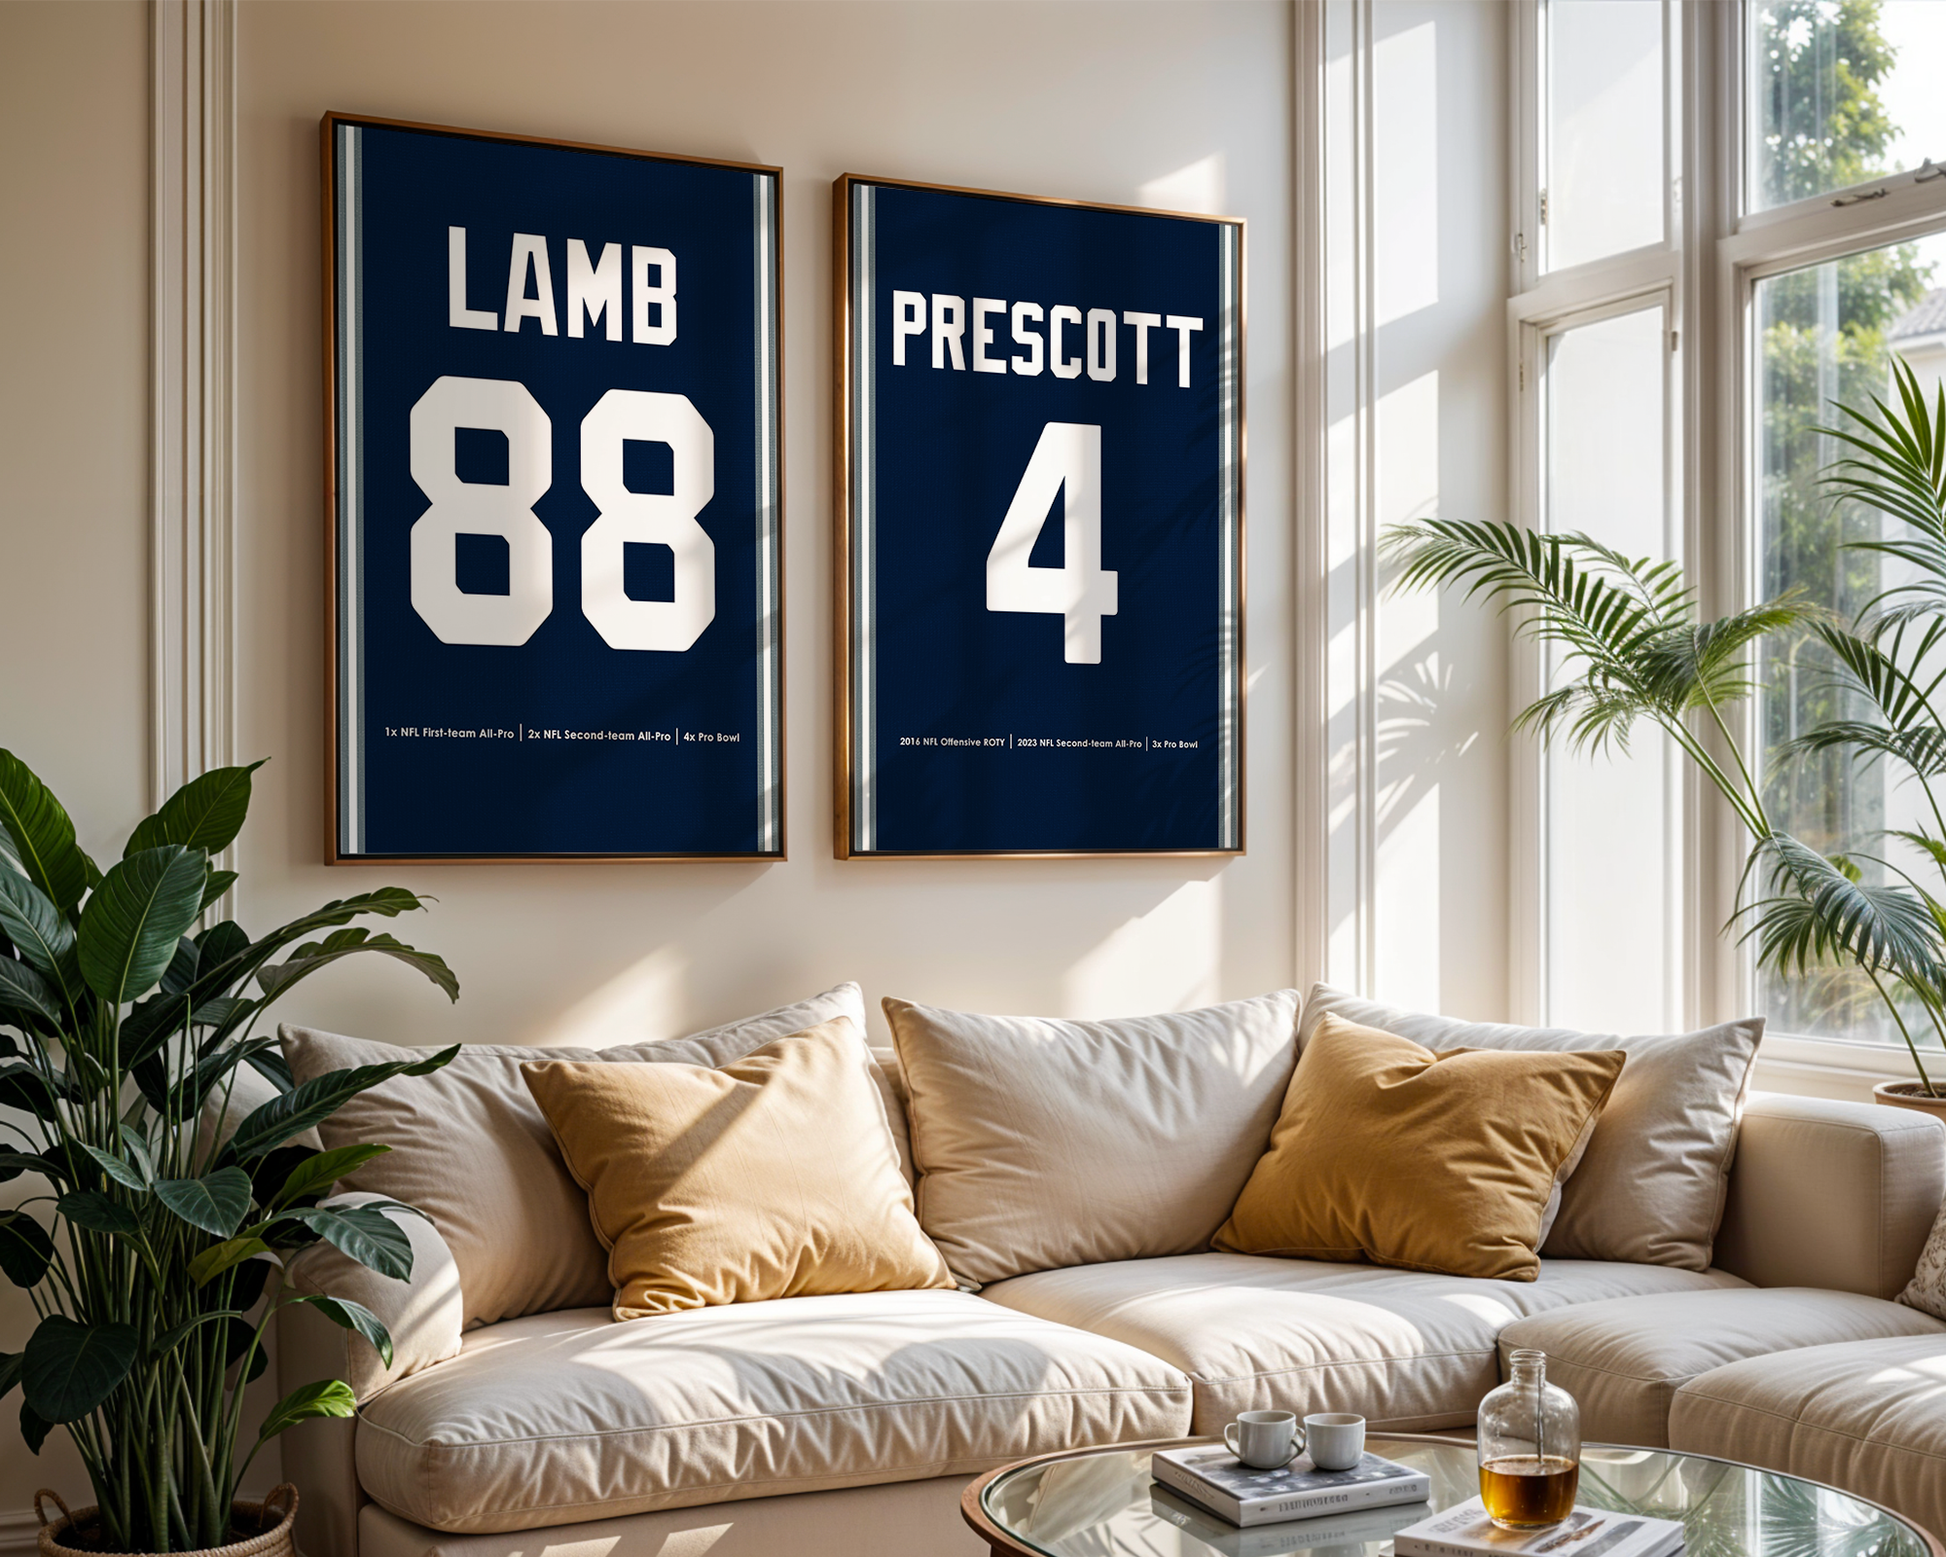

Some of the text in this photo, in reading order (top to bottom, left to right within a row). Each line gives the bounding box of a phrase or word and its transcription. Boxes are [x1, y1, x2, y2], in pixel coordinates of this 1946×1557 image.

[448, 226, 678, 345] LAMB
[892, 290, 1204, 389] PRESCOTT
[409, 376, 716, 652] 88
[986, 421, 1119, 665] 4
[385, 727, 740, 743] 1x NFL First-team All-Pro 2x NFL Second-team All-Pro 4x Pro Bowl
[899, 736, 1198, 749] 2016 NFL Offensive ROTY 2023 NFL Second-team All-Pro 3x Pro Bowl
